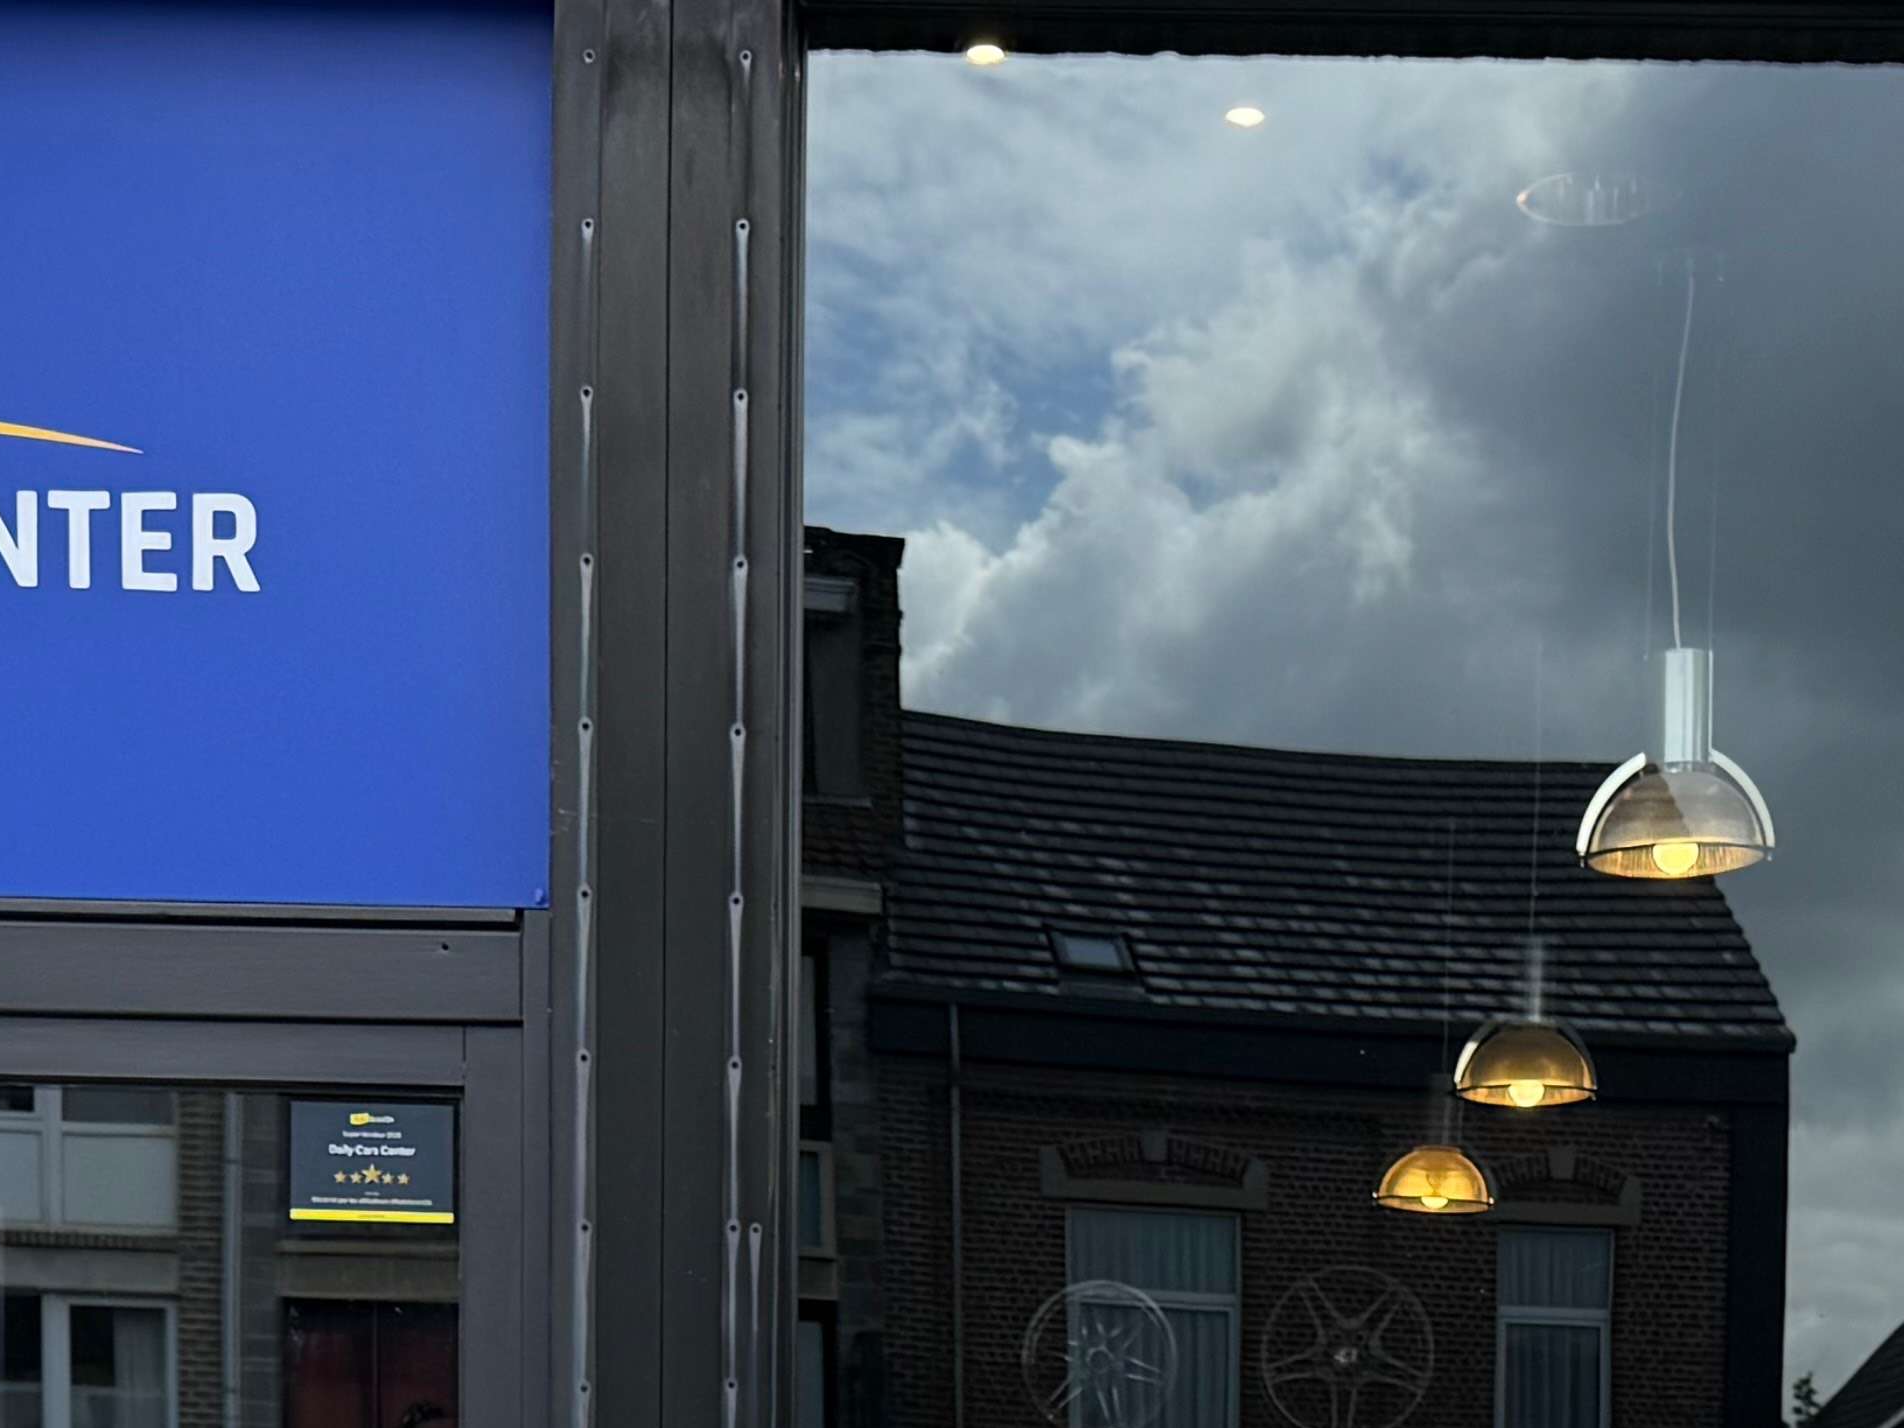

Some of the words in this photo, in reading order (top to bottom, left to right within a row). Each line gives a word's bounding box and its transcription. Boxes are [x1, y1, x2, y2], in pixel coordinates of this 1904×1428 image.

[328, 1144, 353, 1157] Daily
[355, 1144, 379, 1156] Cars
[380, 1145, 416, 1156] Center
